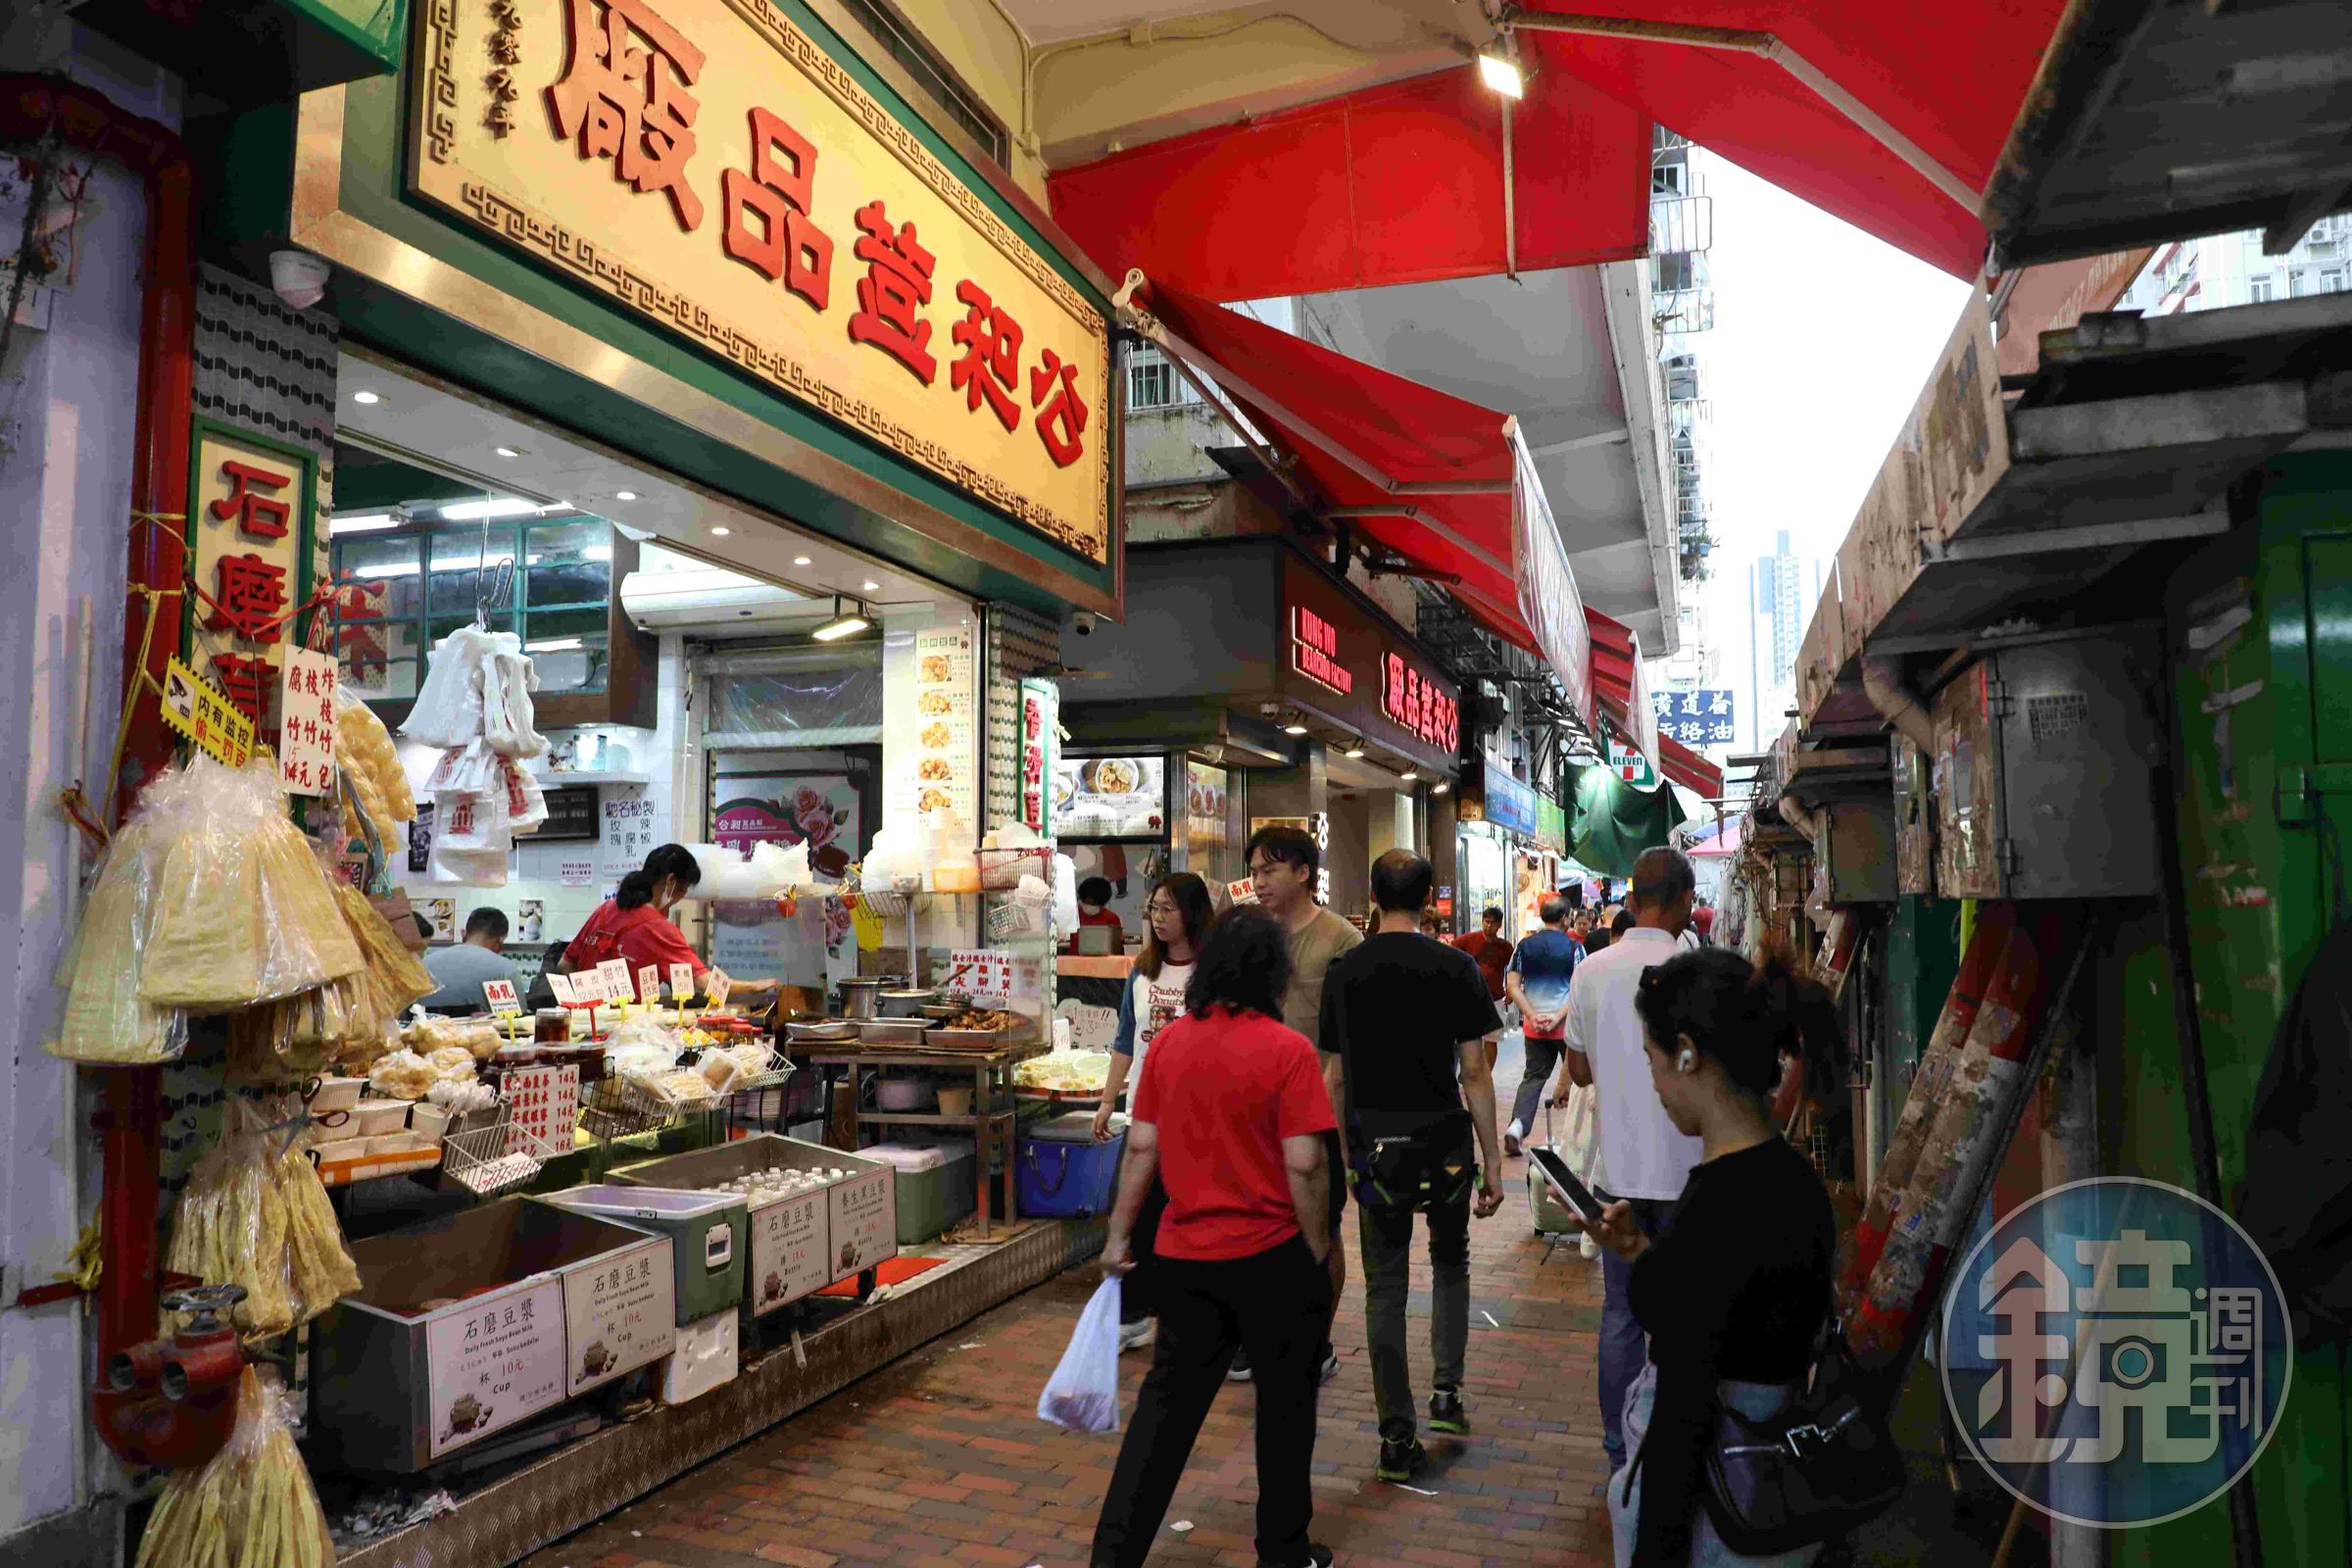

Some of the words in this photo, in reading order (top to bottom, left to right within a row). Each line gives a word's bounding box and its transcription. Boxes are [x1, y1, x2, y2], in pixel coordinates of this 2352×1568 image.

[1301, 607, 1323, 650] KUNG
[1323, 621, 1336, 658] WO
[1331, 662, 1352, 695] FACTORY
[198, 695, 250, 749] 内有监控
[488, 983, 514, 1000] 南乳
[608, 983, 631, 999] 14元
[1149, 984, 1185, 997] Chubby
[1148, 993, 1185, 1006] Donuts
[559, 1072, 576, 1085] 14元
[558, 1088, 576, 1101] 14元
[557, 1103, 575, 1117] 14元
[556, 1121, 574, 1135] 14元
[768, 1201, 813, 1233] 石磨豆漿
[594, 1257, 651, 1294] 石磨豆漿
[464, 1298, 535, 1342] 石磨豆漿
[465, 1345, 479, 1354] Daily
[480, 1339, 494, 1348] Fresh
[495, 1333, 508, 1343] Soya
[508, 1328, 521, 1338] Bean
[521, 1324, 533, 1333] Milk
[479, 1371, 490, 1387] 杯
[503, 1356, 524, 1376] 10元
[493, 1382, 511, 1395] Cup
